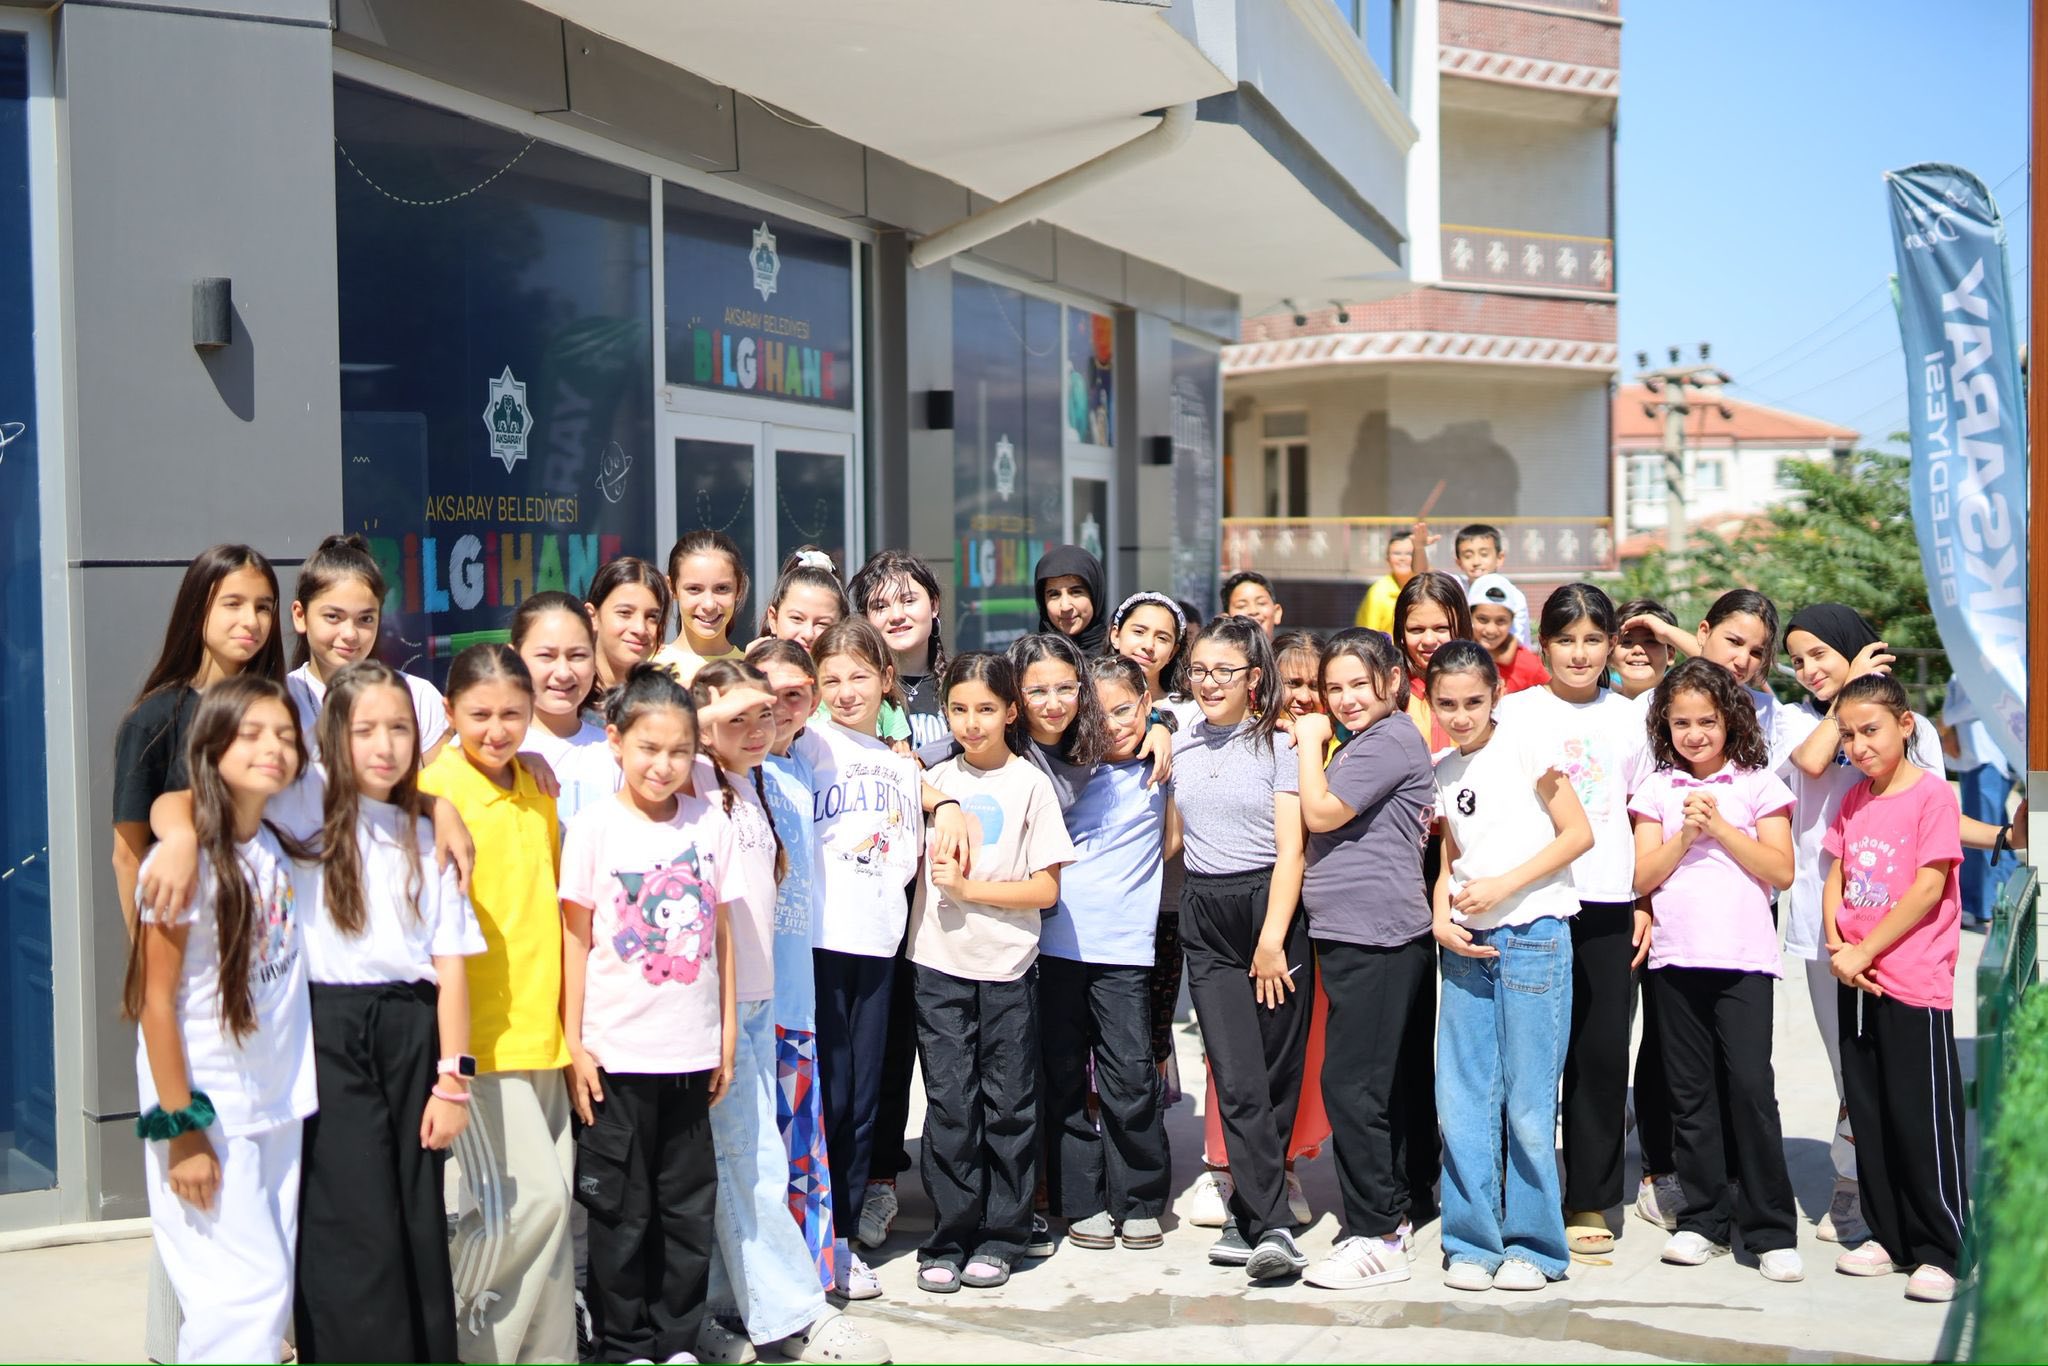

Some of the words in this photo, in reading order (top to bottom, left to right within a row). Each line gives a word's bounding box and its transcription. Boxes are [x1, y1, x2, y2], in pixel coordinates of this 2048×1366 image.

[425, 495, 495, 522] AKSARAY
[498, 491, 579, 523] BELEDİYESİ
[813, 780, 869, 823] LOLA
